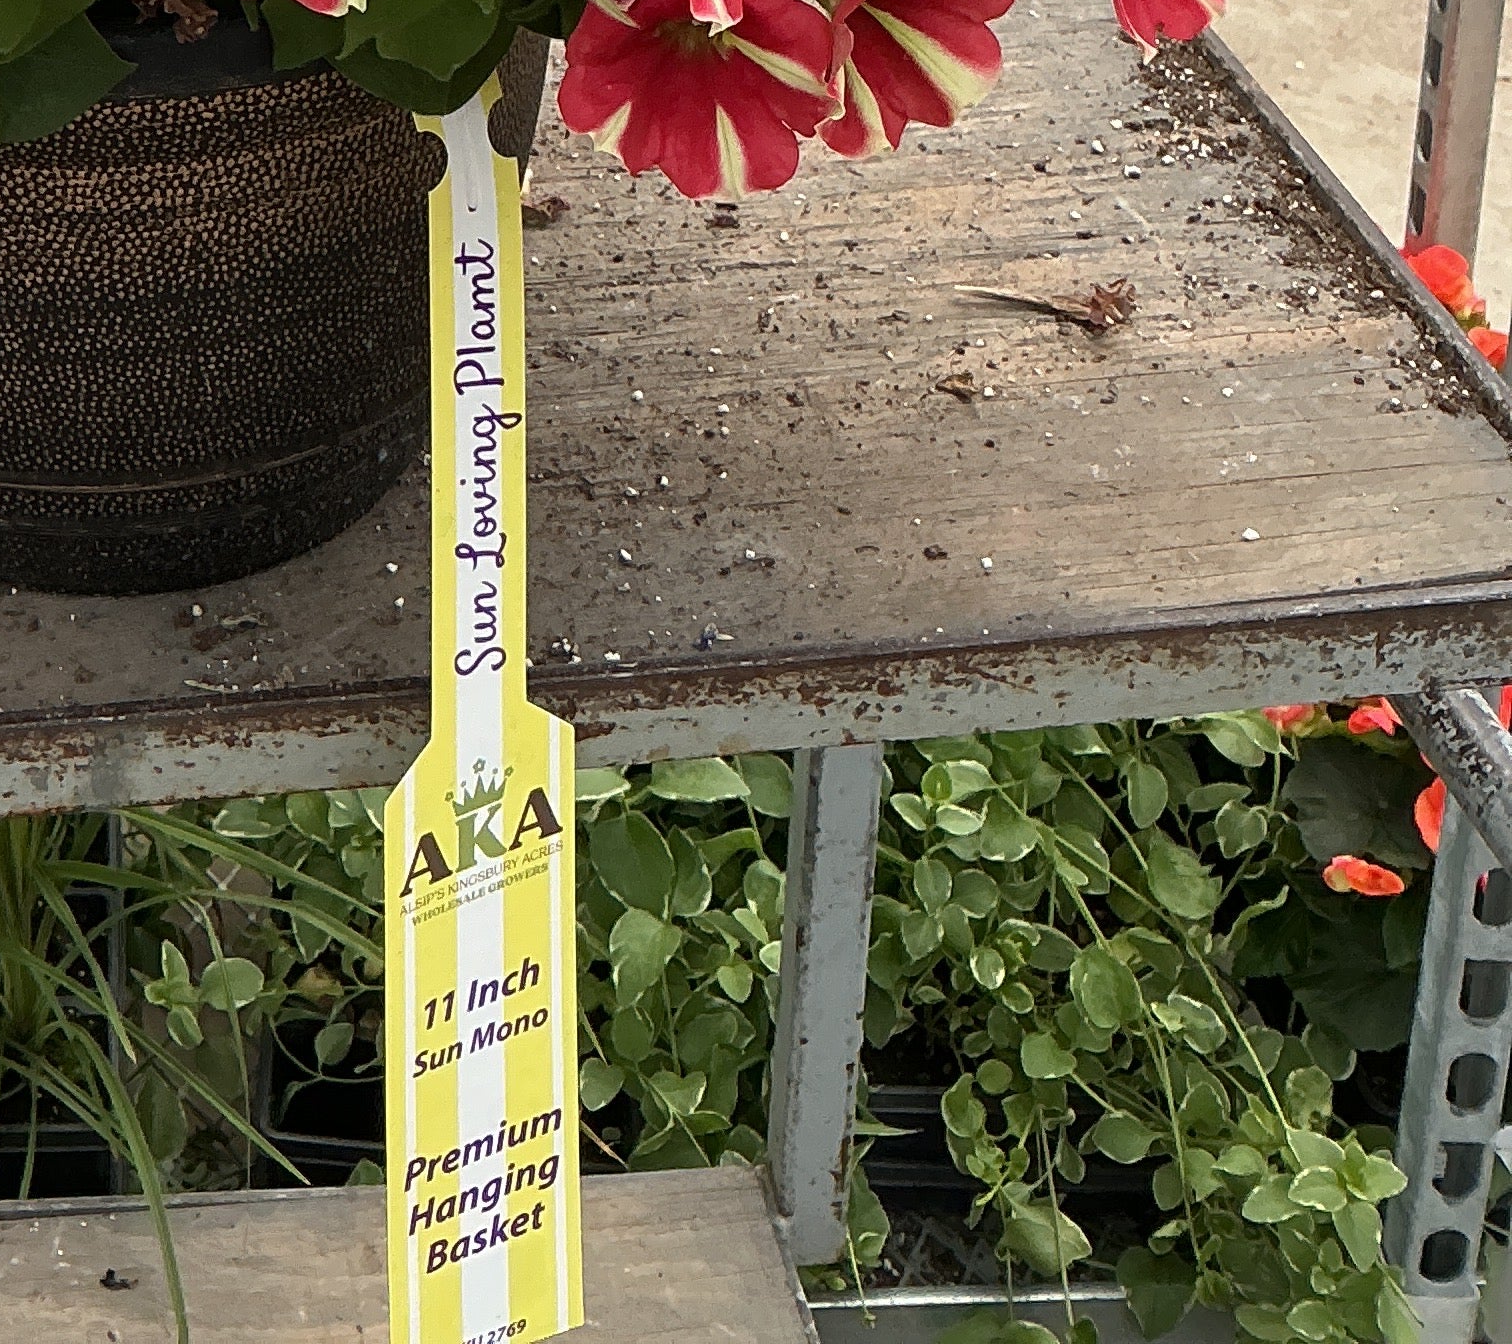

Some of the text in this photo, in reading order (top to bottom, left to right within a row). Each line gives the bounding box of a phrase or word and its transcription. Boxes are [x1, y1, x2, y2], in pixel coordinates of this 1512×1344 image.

[455, 403, 522, 571] Loving
[455, 580, 506, 676] Sun
[399, 787, 563, 898] AKA
[448, 857, 520, 895] KINGSBURY
[522, 840, 564, 865] ACRES
[412, 864, 549, 926] WHOLESALE GROWERS
[424, 957, 540, 1031] 11 Inch
[413, 1008, 549, 1078] Sun Mono
[404, 1107, 562, 1192] Premium
[409, 1155, 560, 1236] Hanging
[426, 1202, 545, 1274] Basket
